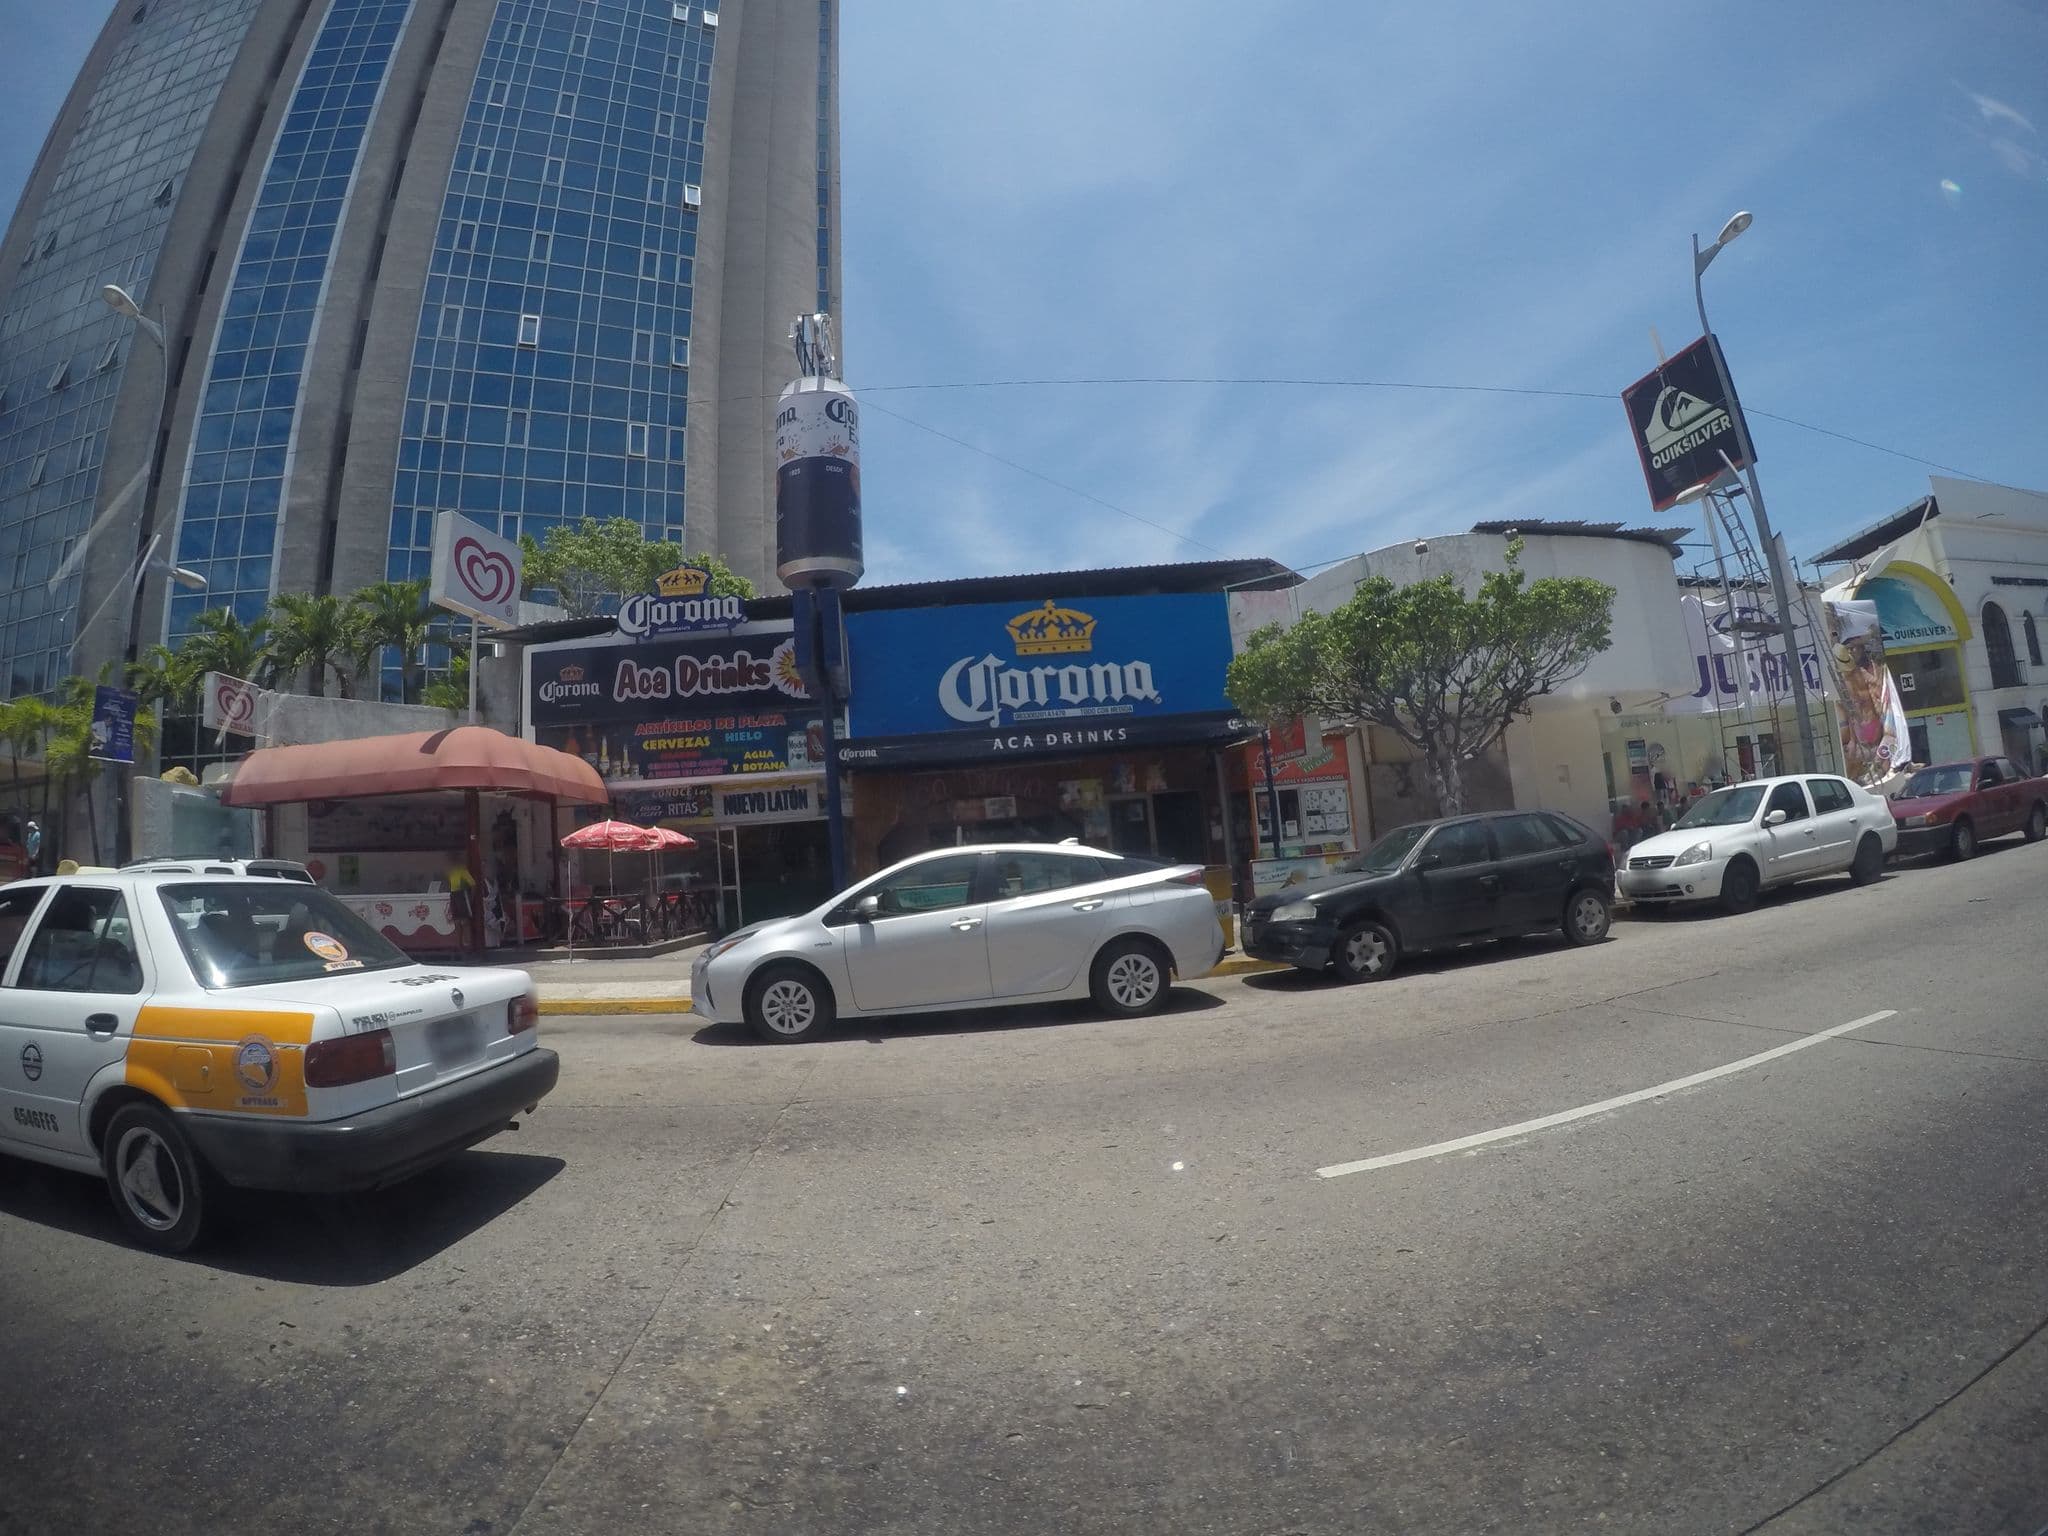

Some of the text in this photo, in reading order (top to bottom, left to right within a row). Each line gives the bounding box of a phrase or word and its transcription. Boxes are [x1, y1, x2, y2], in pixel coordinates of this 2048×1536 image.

[1652, 414, 1732, 470] QUIKSILVER
[618, 594, 743, 636] Corona
[1894, 626, 1947, 640] QUIKSILVER
[615, 654, 771, 699] Aca Drinks
[539, 680, 600, 703] Corona
[939, 653, 1161, 728] Corona
[715, 717, 735, 730] DE
[738, 713, 786, 728] PLAYA
[642, 735, 711, 751] CERVEZAS
[724, 731, 763, 742] HIELO
[993, 728, 1127, 750] ACA DRINKS
[744, 750, 775, 760] AGUA
[839, 747, 877, 762] Corona
[732, 763, 739, 773] Y
[742, 761, 787, 772] BOTANA
[652, 786, 692, 798] CONOCE
[667, 801, 699, 816] RITAS
[723, 791, 766, 816] NUEVO
